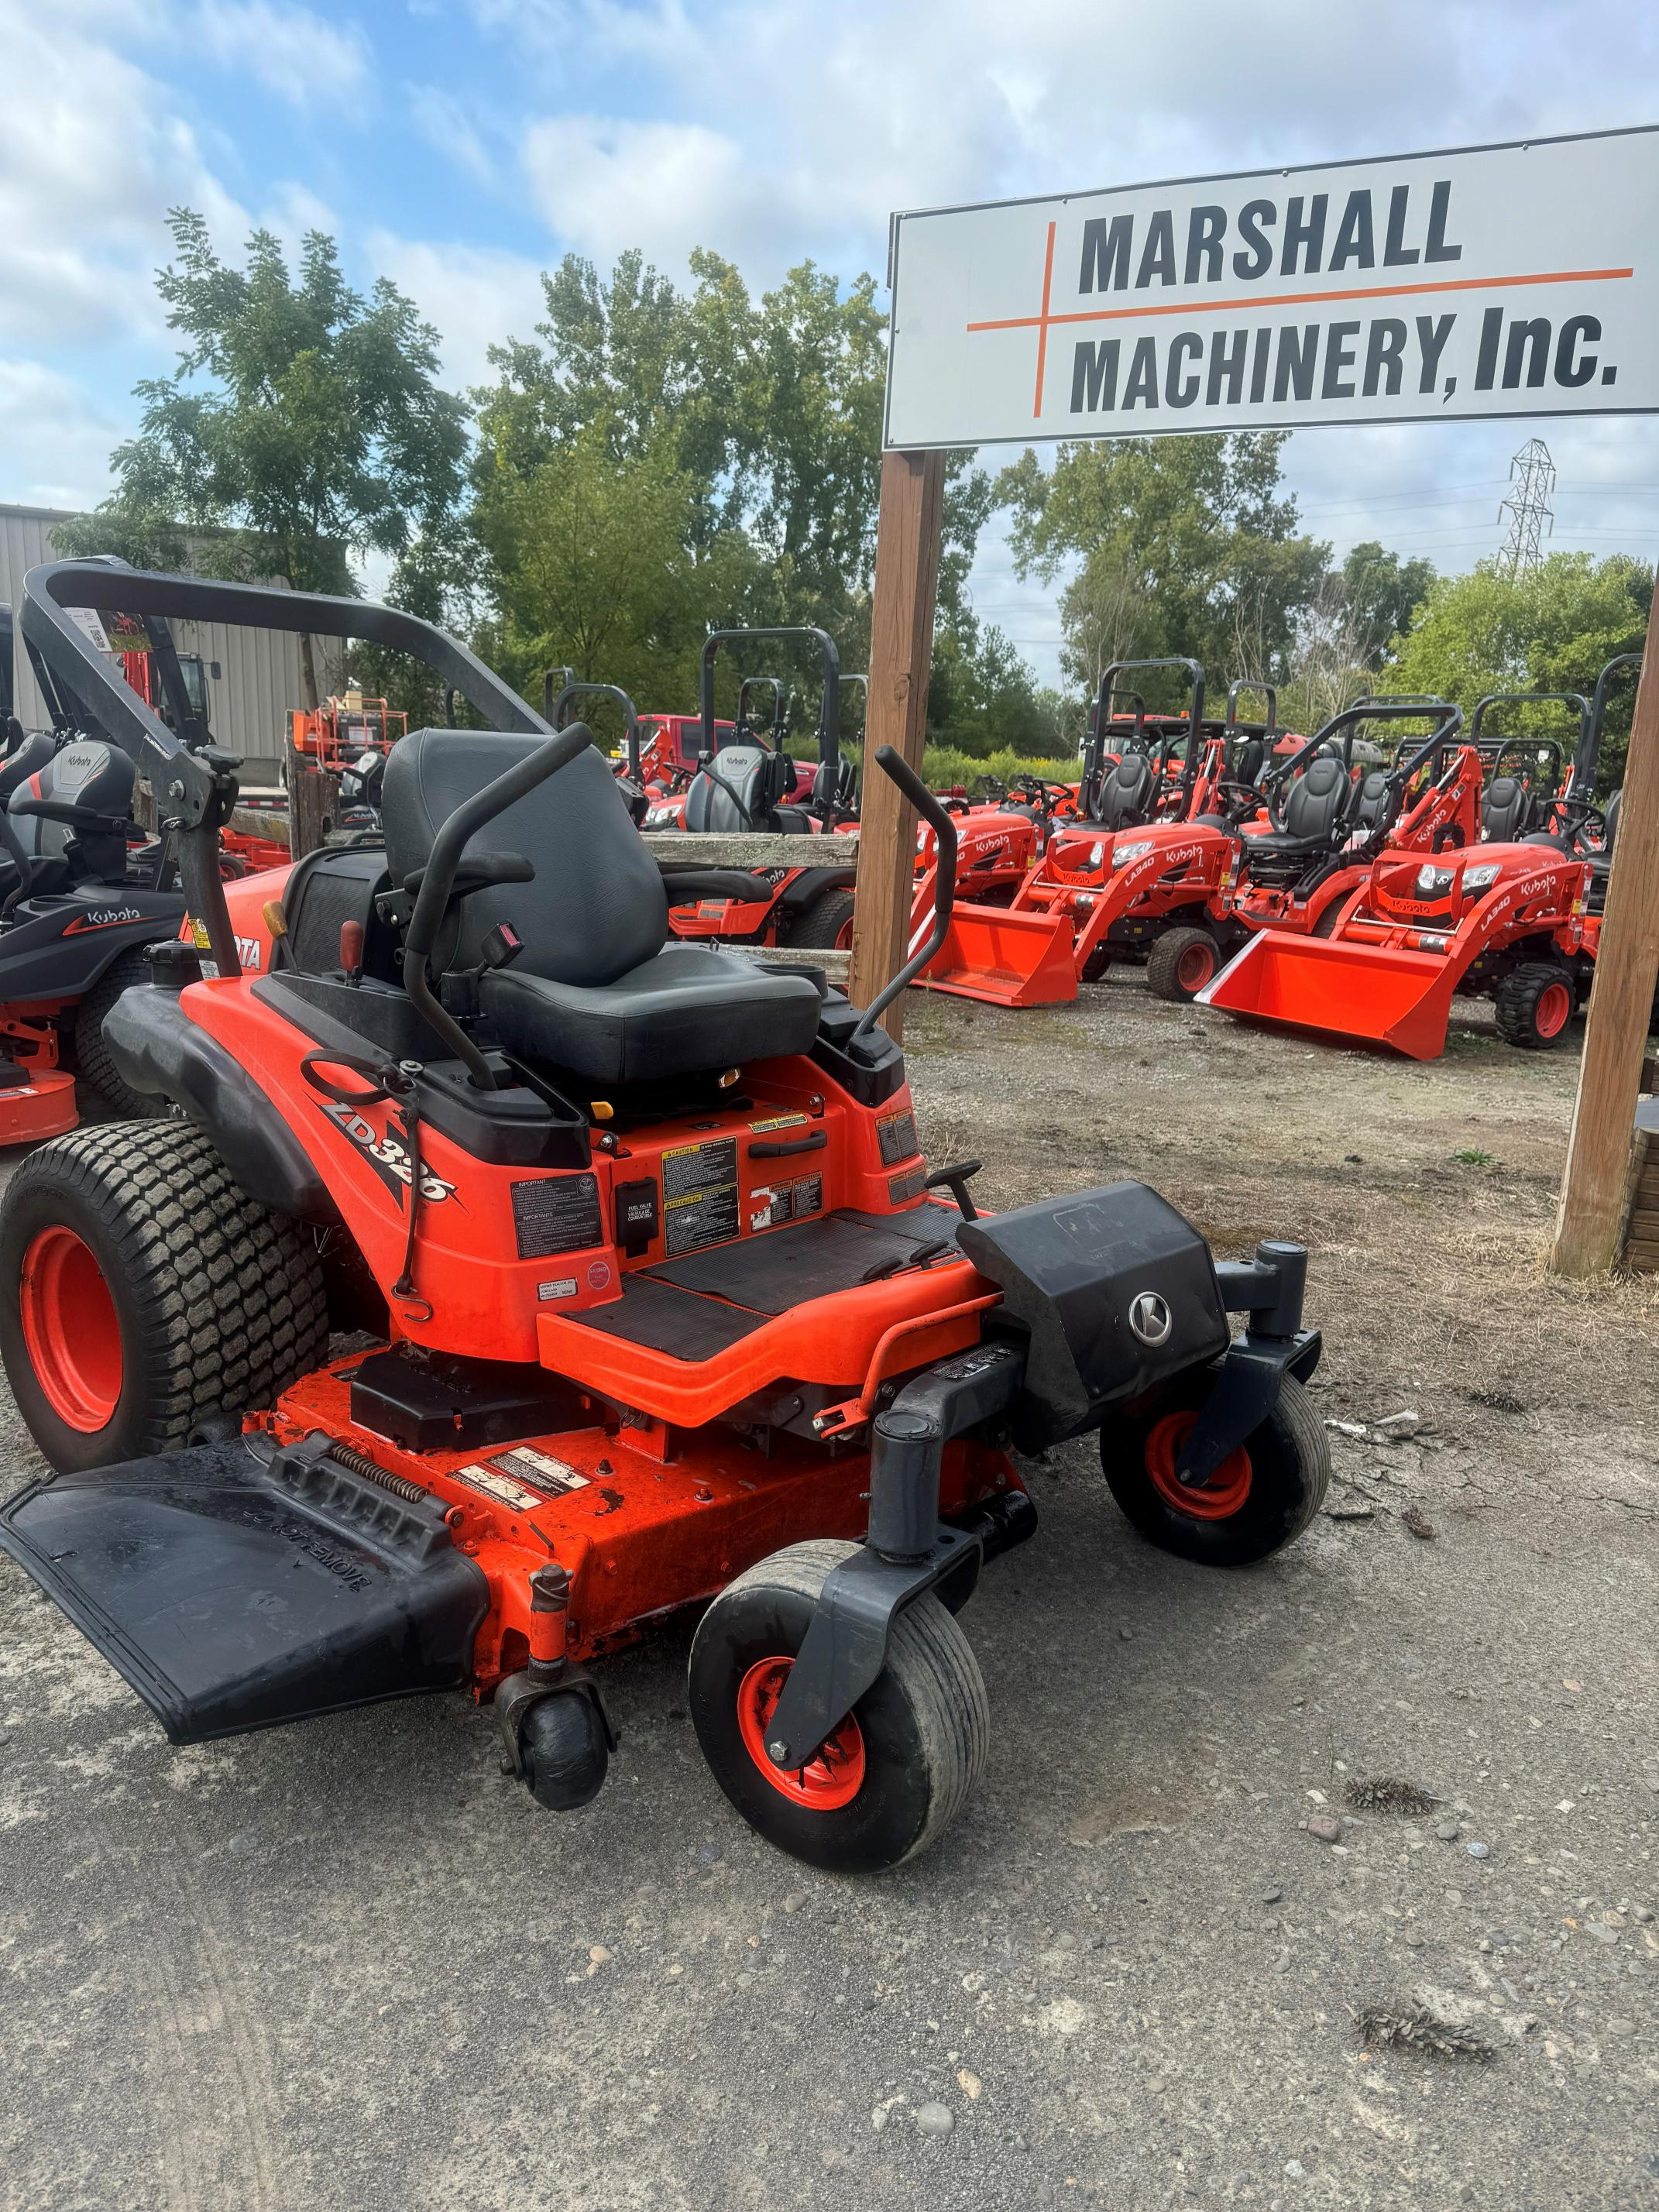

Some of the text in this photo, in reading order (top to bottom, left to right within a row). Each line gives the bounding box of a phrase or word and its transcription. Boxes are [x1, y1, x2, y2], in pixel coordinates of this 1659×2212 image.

[1079, 180, 1462, 294] MARSHALL
[1070, 307, 1618, 414] MACHINERY, Inc.
[68, 755, 91, 766] Kubota
[726, 757, 748, 765] Kubota
[1417, 809, 1447, 843] Kubota
[976, 834, 1010, 852] Kubota
[1166, 844, 1203, 863] Kubota
[1063, 873, 1091, 884] Kubota
[1125, 857, 1155, 887] LA340
[1521, 874, 1557, 896] Kubota
[1393, 899, 1431, 914] Kubota
[1480, 895, 1511, 932] LA340
[88, 907, 140, 924] Kubota
[672, 1147, 693, 1156] CAUTION
[518, 1179, 546, 1187] IMPORTANT
[523, 1212, 553, 1221] IMPORTANTE
[501, 1475, 526, 1491] DANGER
